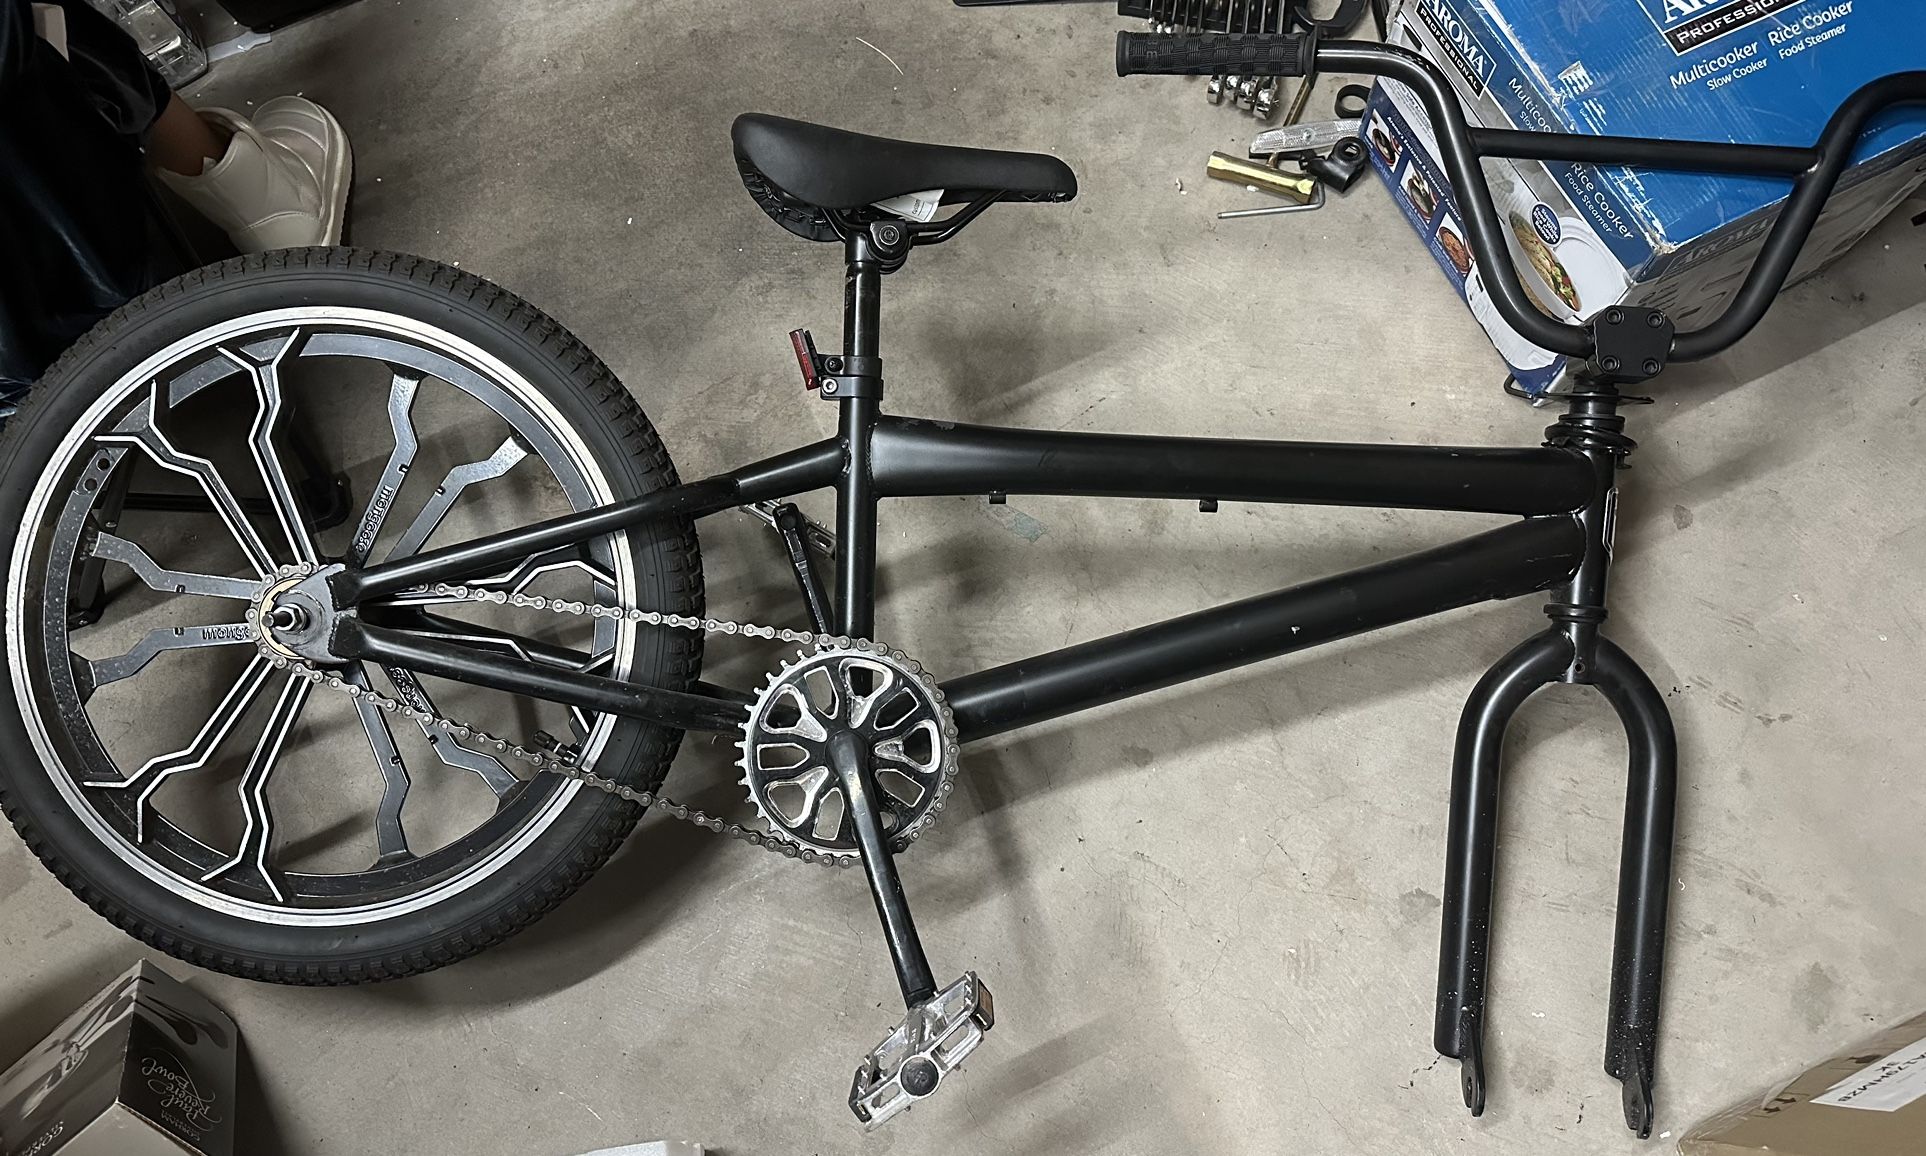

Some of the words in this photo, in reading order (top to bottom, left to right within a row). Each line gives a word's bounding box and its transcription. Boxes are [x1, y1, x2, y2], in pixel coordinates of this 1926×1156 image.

[1419, 8, 1478, 90] PROFESSIONAL
[1426, 0, 1484, 77] AROMA
[1669, 40, 1759, 90] Multicooker
[1768, 22, 1802, 47] Rice
[1802, 1, 1853, 30] Cooker
[1676, 0, 1780, 44] PROFESSIO
[1706, 73, 1732, 91] Slow
[1732, 57, 1768, 79] Cooker
[1779, 40, 1805, 60] Food
[1805, 23, 1847, 47] Steamer
[1508, 78, 1557, 133] Multicoo
[1564, 172, 1583, 197] Food
[1581, 196, 1613, 233] Steamer
[1571, 162, 1594, 192] Rice
[1594, 191, 1634, 240] Cooker
[355, 485, 394, 553] mongoose
[141, 1057, 189, 1089] Bowl
[161, 1092, 213, 1131] Paul
